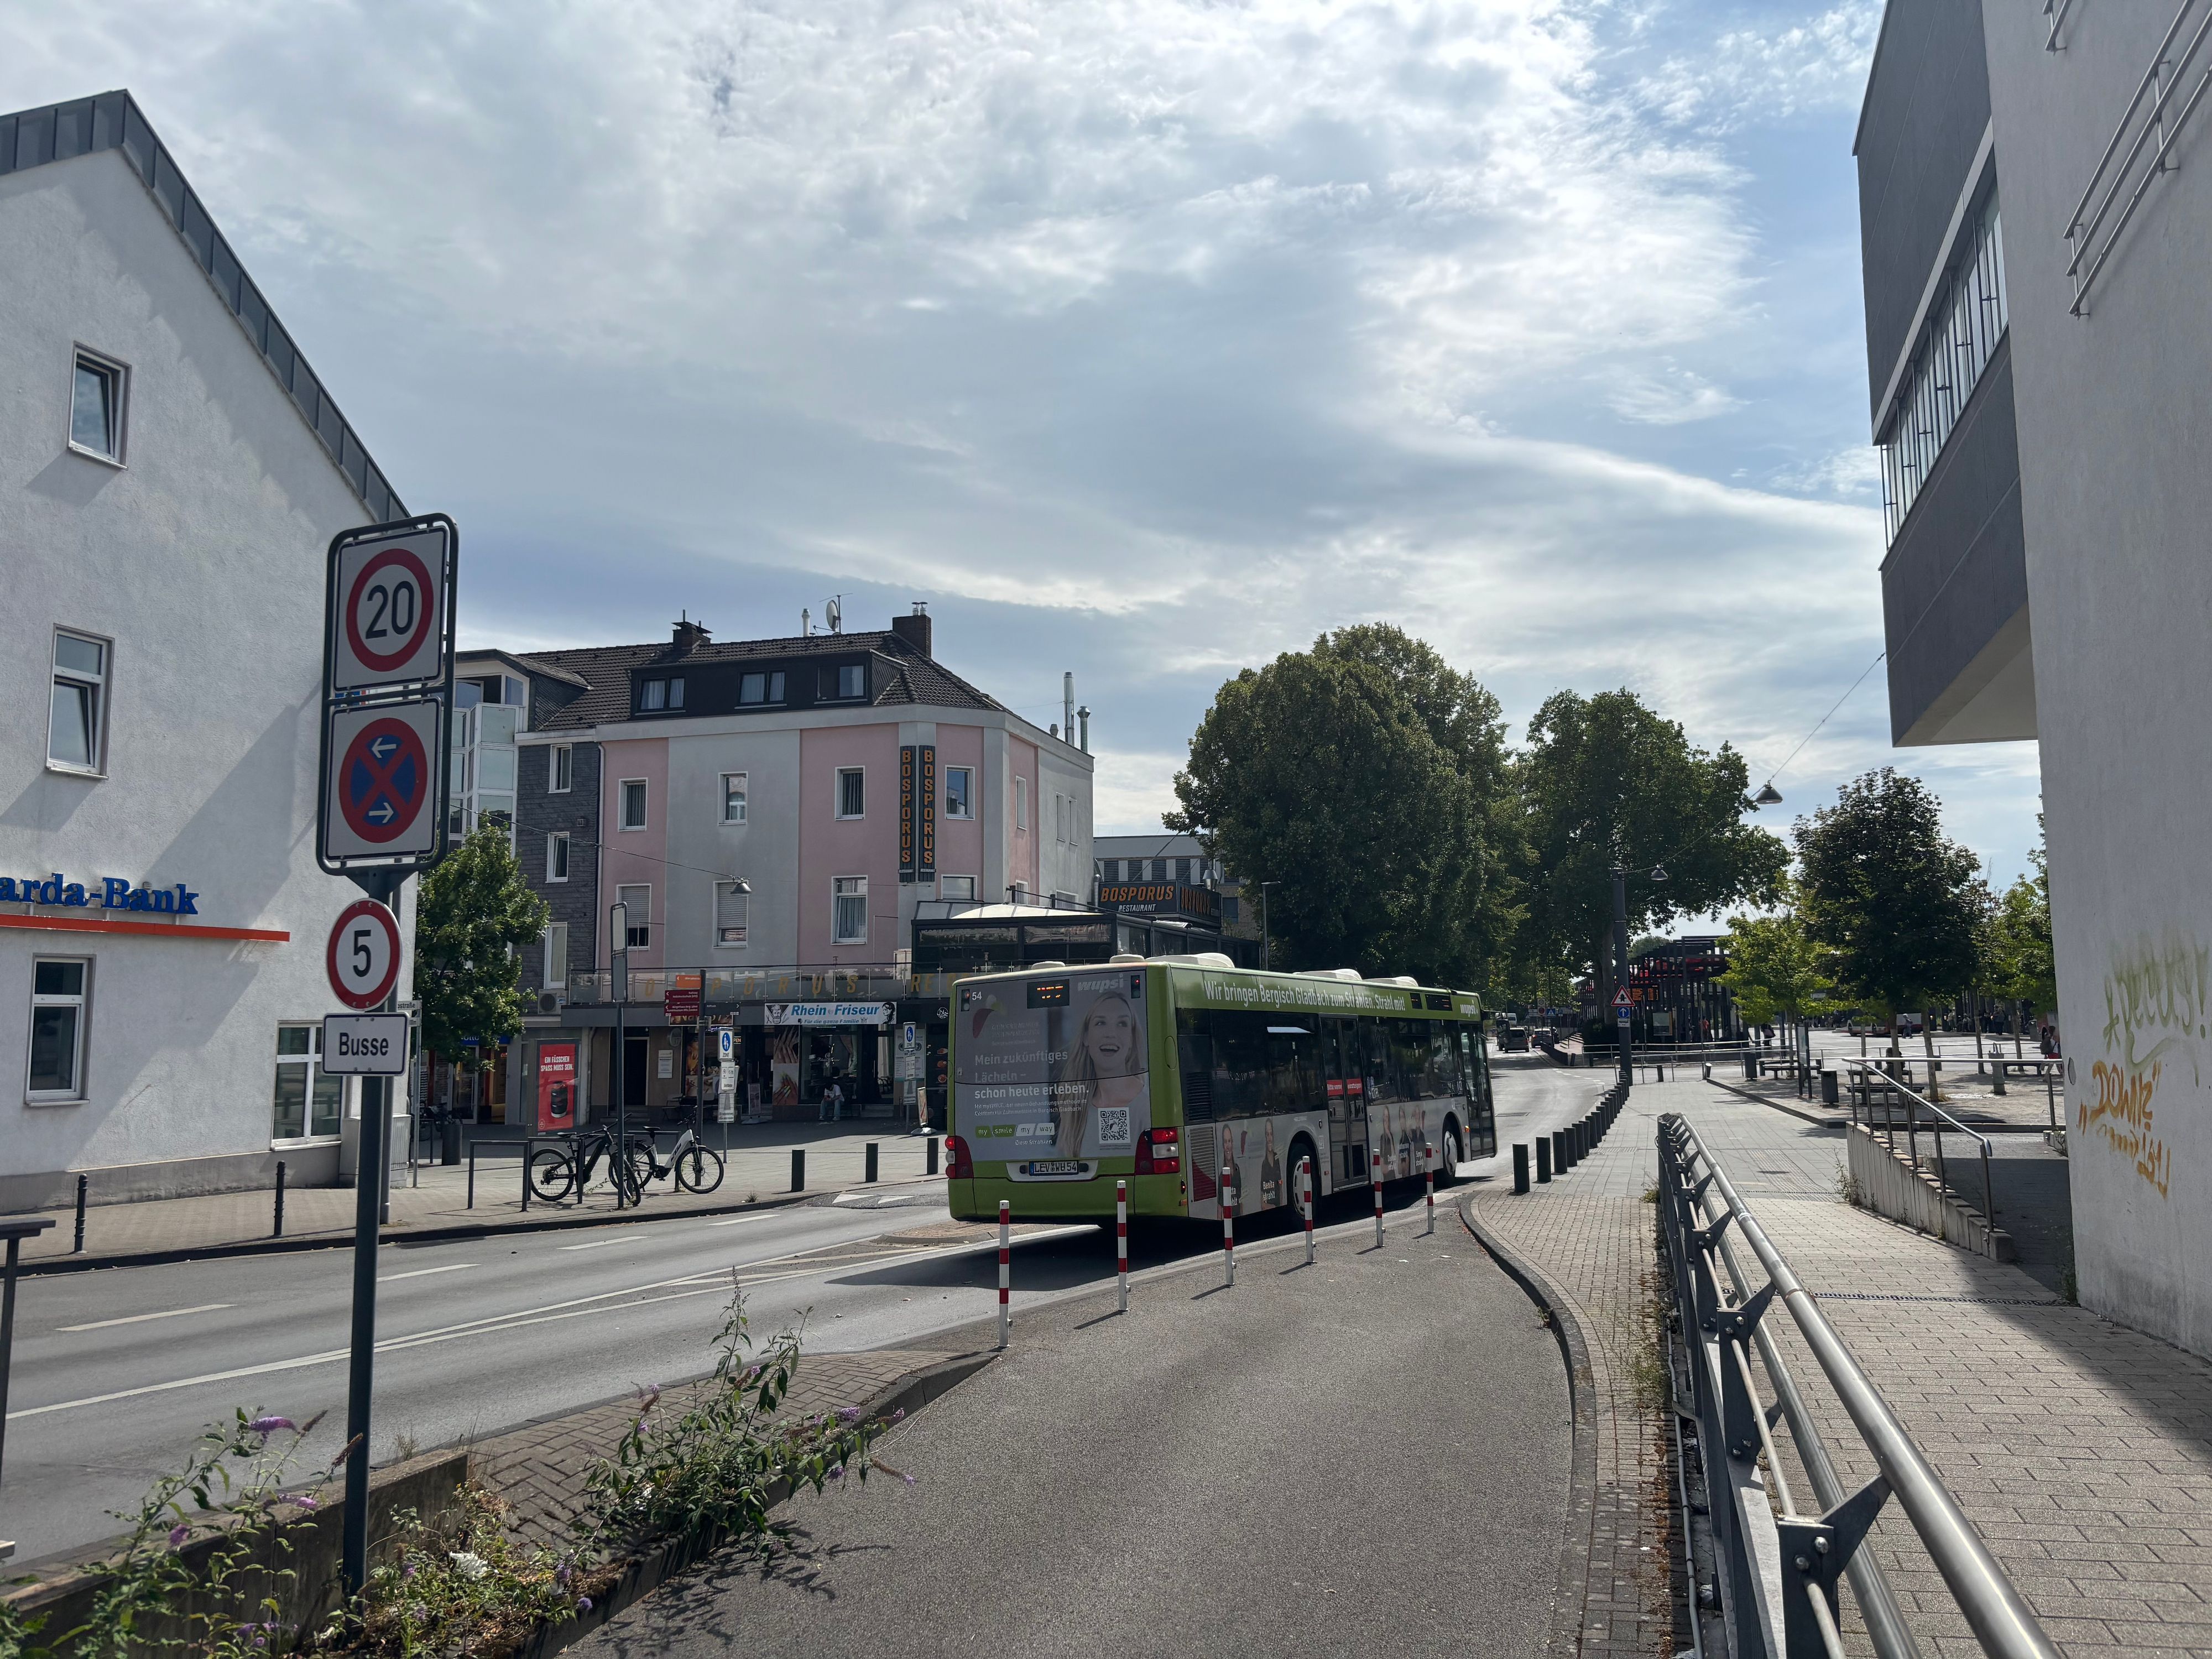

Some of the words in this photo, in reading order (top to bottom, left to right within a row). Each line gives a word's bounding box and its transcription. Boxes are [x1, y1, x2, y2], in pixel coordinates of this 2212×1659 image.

[366, 581, 414, 639] 20
[902, 750, 911, 863] BOSPORUS
[924, 750, 933, 864] BOSPORUS
[1100, 885, 1174, 902] BOSPORUS
[1118, 904, 1156, 912] RESTAURANT
[353, 929, 372, 977] 5
[1078, 973, 1124, 993] wupsi
[972, 992, 982, 1000] 54
[1204, 980, 1222, 1000] Wir
[1224, 982, 1259, 1007] bringen
[1259, 984, 1295, 1008] Bergisch
[1295, 987, 1329, 1006] Gladbach
[1331, 994, 1344, 1007] zum
[1345, 992, 1375, 1009] Strahlen.
[1375, 992, 1394, 1010] Strahl
[1394, 996, 1406, 1011] mit!
[791, 1004, 827, 1016] Rhein
[834, 1004, 880, 1016] Friseur
[1460, 1000, 1476, 1017] wupsi
[339, 1032, 389, 1056] Busse
[975, 1054, 1000, 1066] Mein
[1003, 1050, 1068, 1064] zukünftiges
[975, 1071, 1018, 1083] Lächeln
[974, 1087, 1006, 1099] schon
[1009, 1086, 1040, 1097] heute
[1042, 1083, 1089, 1095] erleben.
[1035, 1163, 1050, 1172] LEV
[1067, 1162, 1076, 1171] 54
